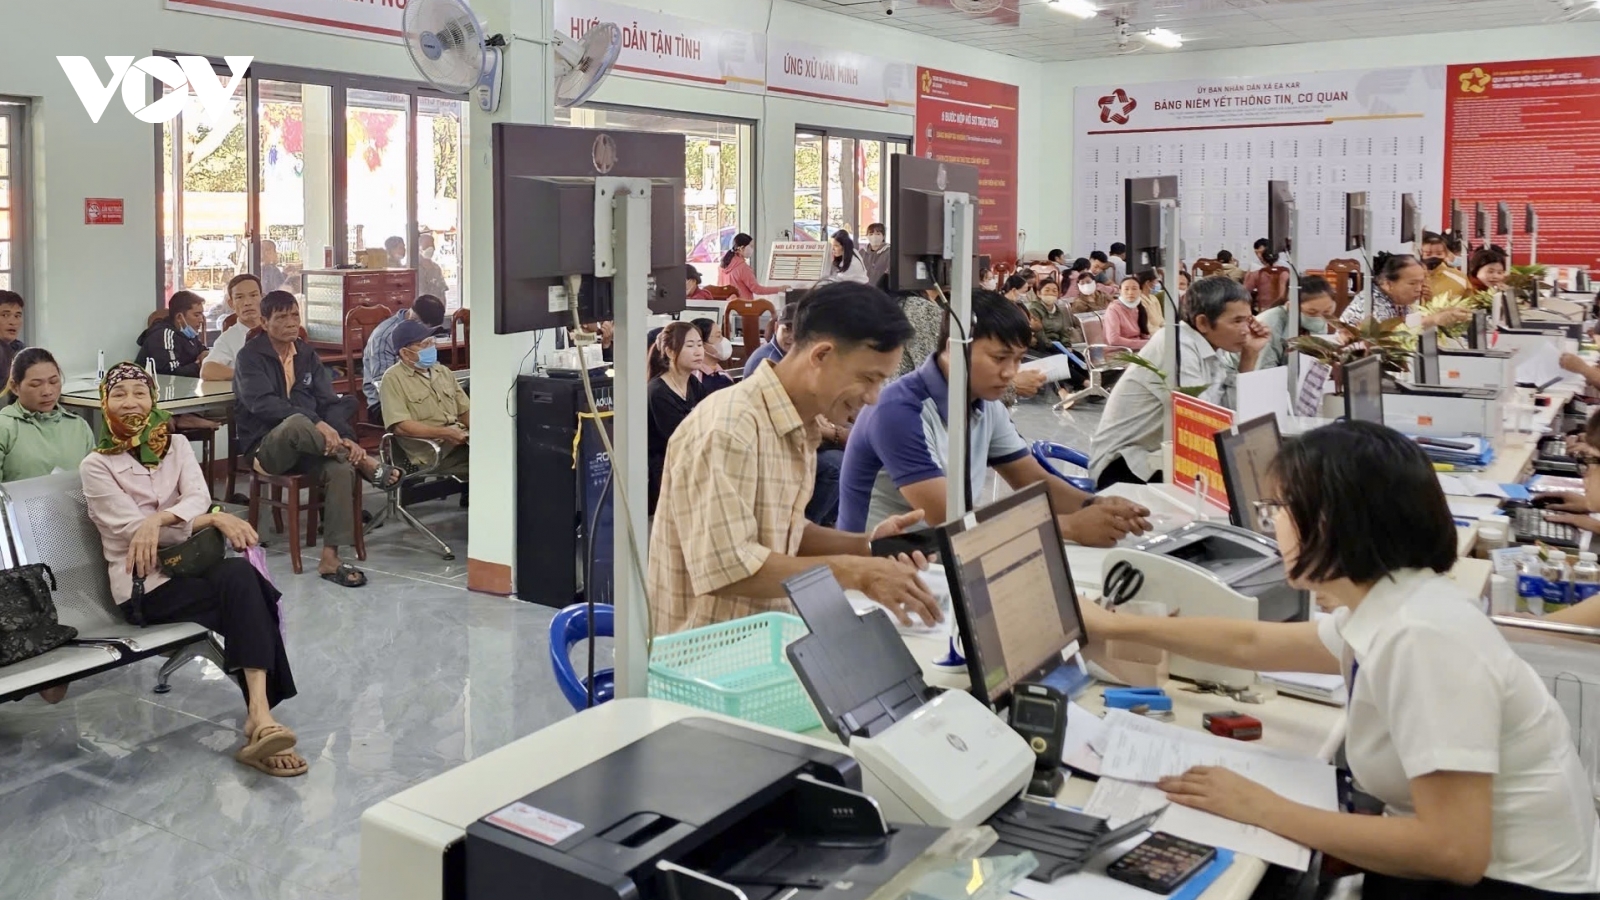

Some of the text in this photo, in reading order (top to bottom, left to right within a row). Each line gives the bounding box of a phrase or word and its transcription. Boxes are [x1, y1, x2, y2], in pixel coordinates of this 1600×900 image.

[622, 21, 647, 51] DẪN
[651, 29, 672, 58] TẬN
[675, 33, 701, 60] TÌNH
[784, 52, 803, 76] ỨNG
[837, 64, 858, 85] MINH
[1208, 84, 1222, 93] BAN
[1224, 83, 1245, 92] NHÂN
[1246, 82, 1261, 91] DÂN
[1285, 81, 1300, 89] KAR
[1154, 99, 1182, 110] BẢNG
[1213, 94, 1233, 107] YẾT
[1235, 95, 1271, 106] THÔNG
[1274, 94, 1294, 105] TIN,
[1297, 92, 1313, 103] CƠ
[1317, 91, 1348, 103] QUAN
